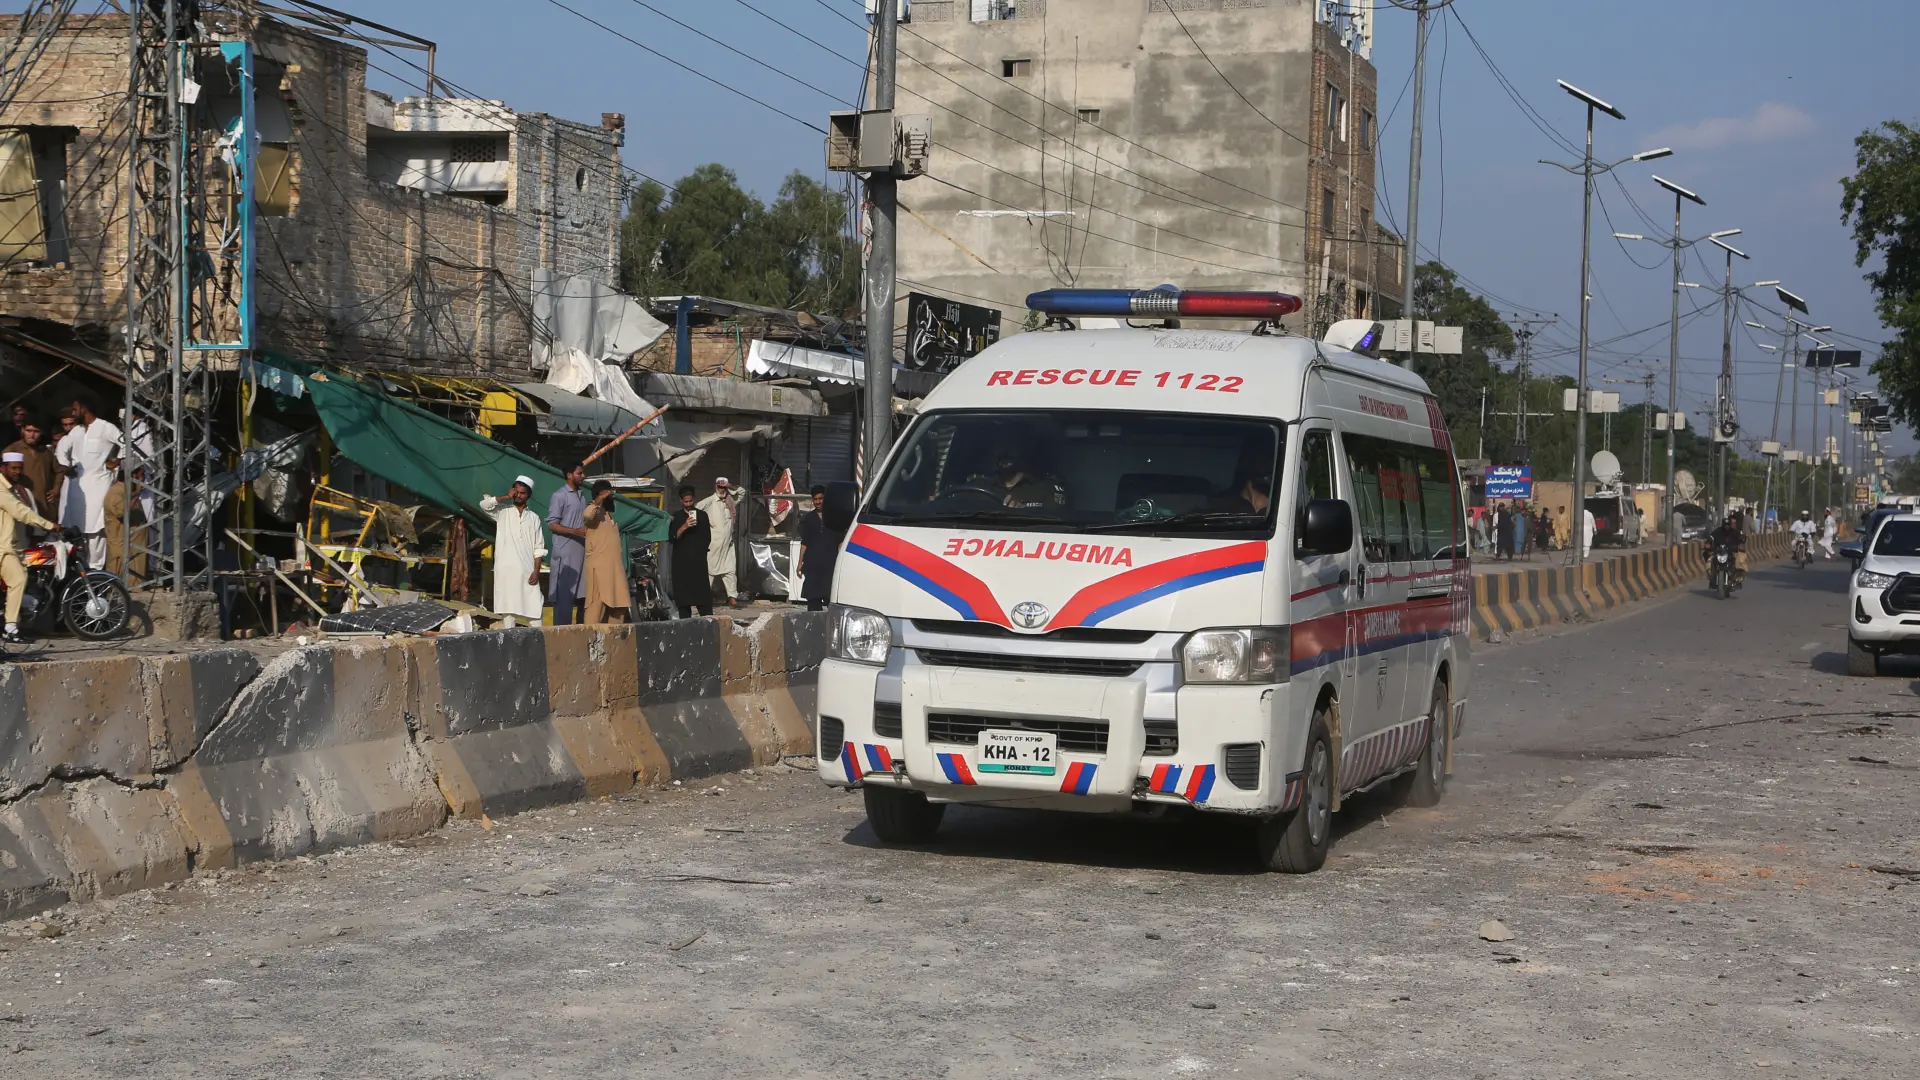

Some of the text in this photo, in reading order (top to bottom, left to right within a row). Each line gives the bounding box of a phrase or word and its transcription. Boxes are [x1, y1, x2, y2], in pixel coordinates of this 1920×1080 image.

[945, 303, 960, 325] Haji
[986, 369, 1244, 393] RESCUE 1122
[984, 744, 1018, 760] KHA
[1033, 747, 1050, 762] 12
